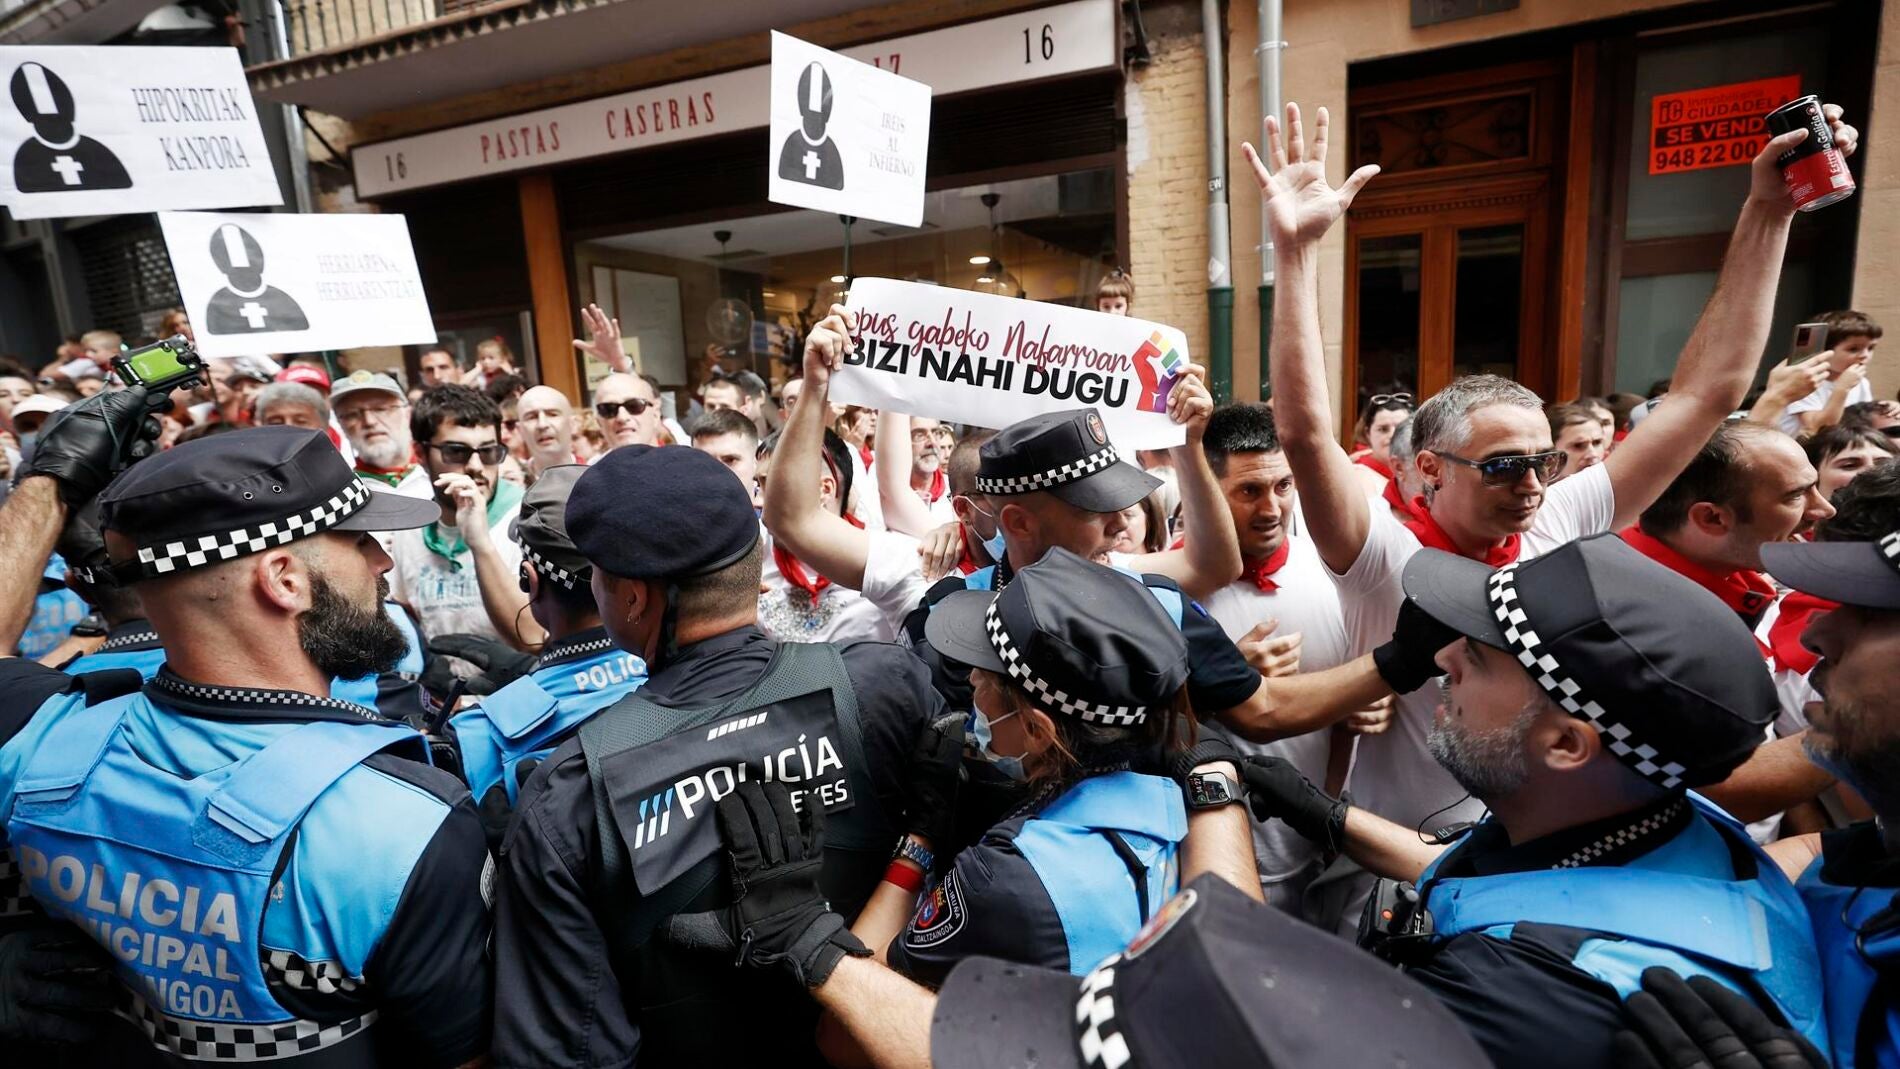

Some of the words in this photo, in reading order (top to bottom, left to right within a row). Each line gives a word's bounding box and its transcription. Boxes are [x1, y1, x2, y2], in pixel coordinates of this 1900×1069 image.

[131, 87, 248, 122] HIPOKRITAK
[385, 152, 408, 182] 16
[480, 121, 561, 164] PASTAS
[606, 92, 716, 140] CASERAS
[1023, 23, 1055, 65] 16
[1666, 125, 1695, 145] SE
[1700, 116, 1766, 139] VEND
[159, 135, 251, 170] KANPORA
[1656, 149, 1695, 169] 948
[1700, 143, 1727, 164] 22
[1730, 139, 1758, 160] 00
[908, 307, 990, 357] gabeko
[1003, 321, 1132, 373] Nafarroan
[843, 335, 910, 375] BIZI
[919, 346, 1015, 392] NAHI
[1023, 362, 1130, 409] DUGU
[574, 654, 644, 693] POLIC
[20, 844, 242, 944] POLICIA
